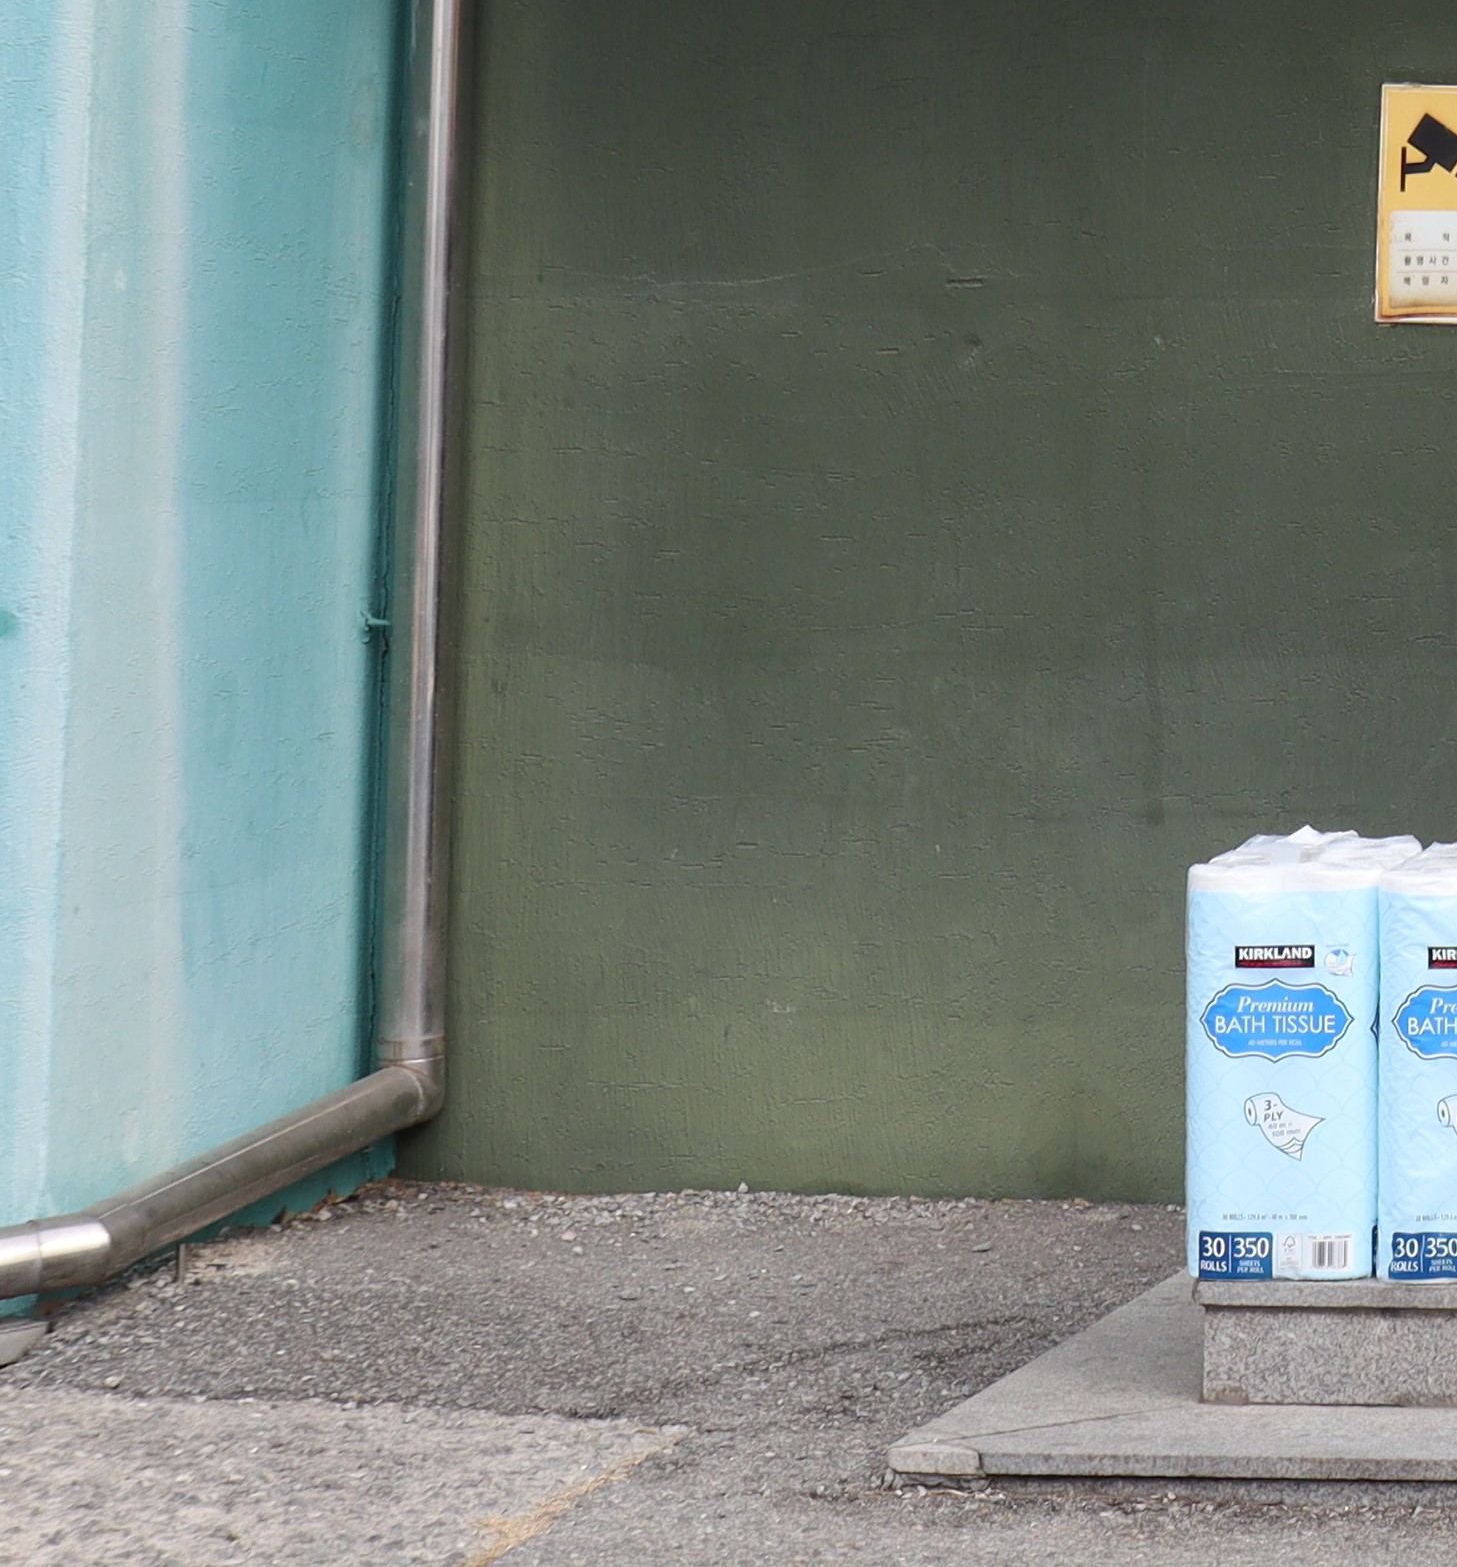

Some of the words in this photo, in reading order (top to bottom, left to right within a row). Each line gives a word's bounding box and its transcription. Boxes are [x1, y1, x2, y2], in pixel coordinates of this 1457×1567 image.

[1238, 948, 1313, 961] KIRKLAND
[1237, 996, 1315, 1013] Premium
[1215, 1015, 1266, 1033] BATH
[1272, 1015, 1336, 1033] TISSUE
[1407, 1017, 1457, 1035] BATH
[1263, 1112, 1284, 1122] PLY
[1202, 1236, 1225, 1258] 30
[1233, 1236, 1269, 1258] 350
[1394, 1237, 1419, 1258] 30
[1200, 1259, 1228, 1272] ROLLS
[1390, 1260, 1419, 1272] ROLLS
